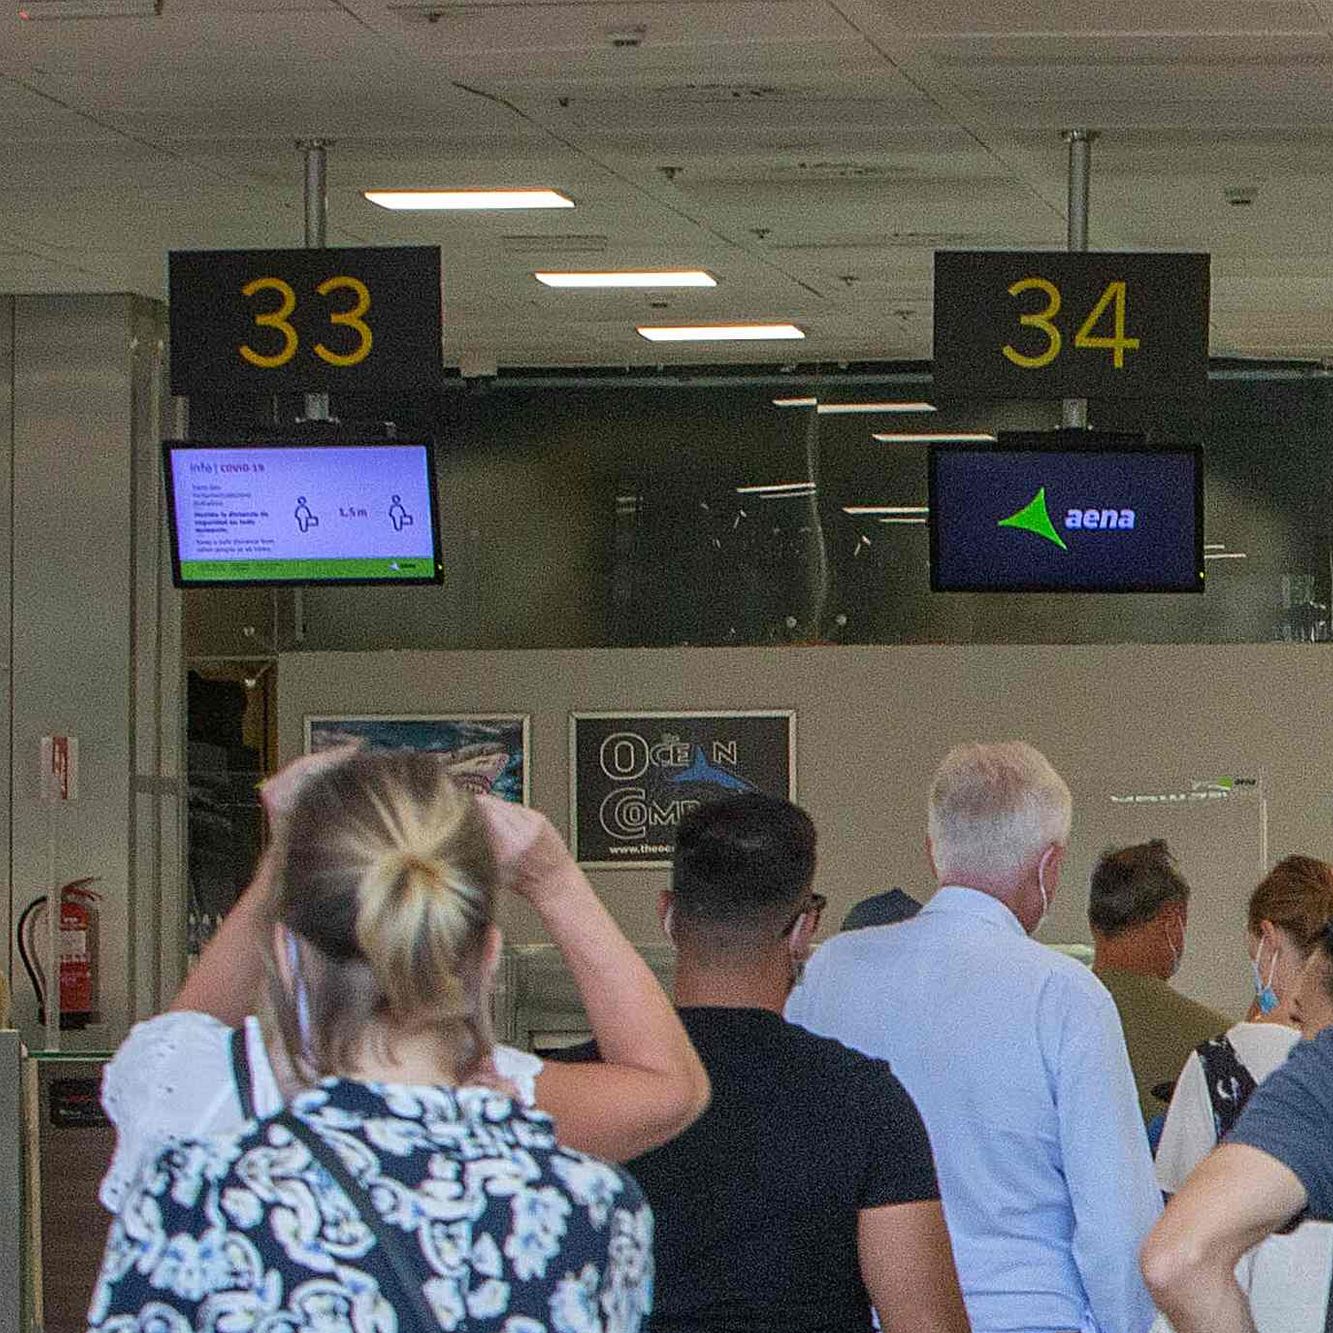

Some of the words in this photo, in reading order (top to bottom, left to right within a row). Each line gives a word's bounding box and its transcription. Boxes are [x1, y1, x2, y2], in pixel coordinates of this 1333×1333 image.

[239, 275, 373, 368] 33
[1001, 277, 1140, 369] 34
[1065, 508, 1135, 530] aena
